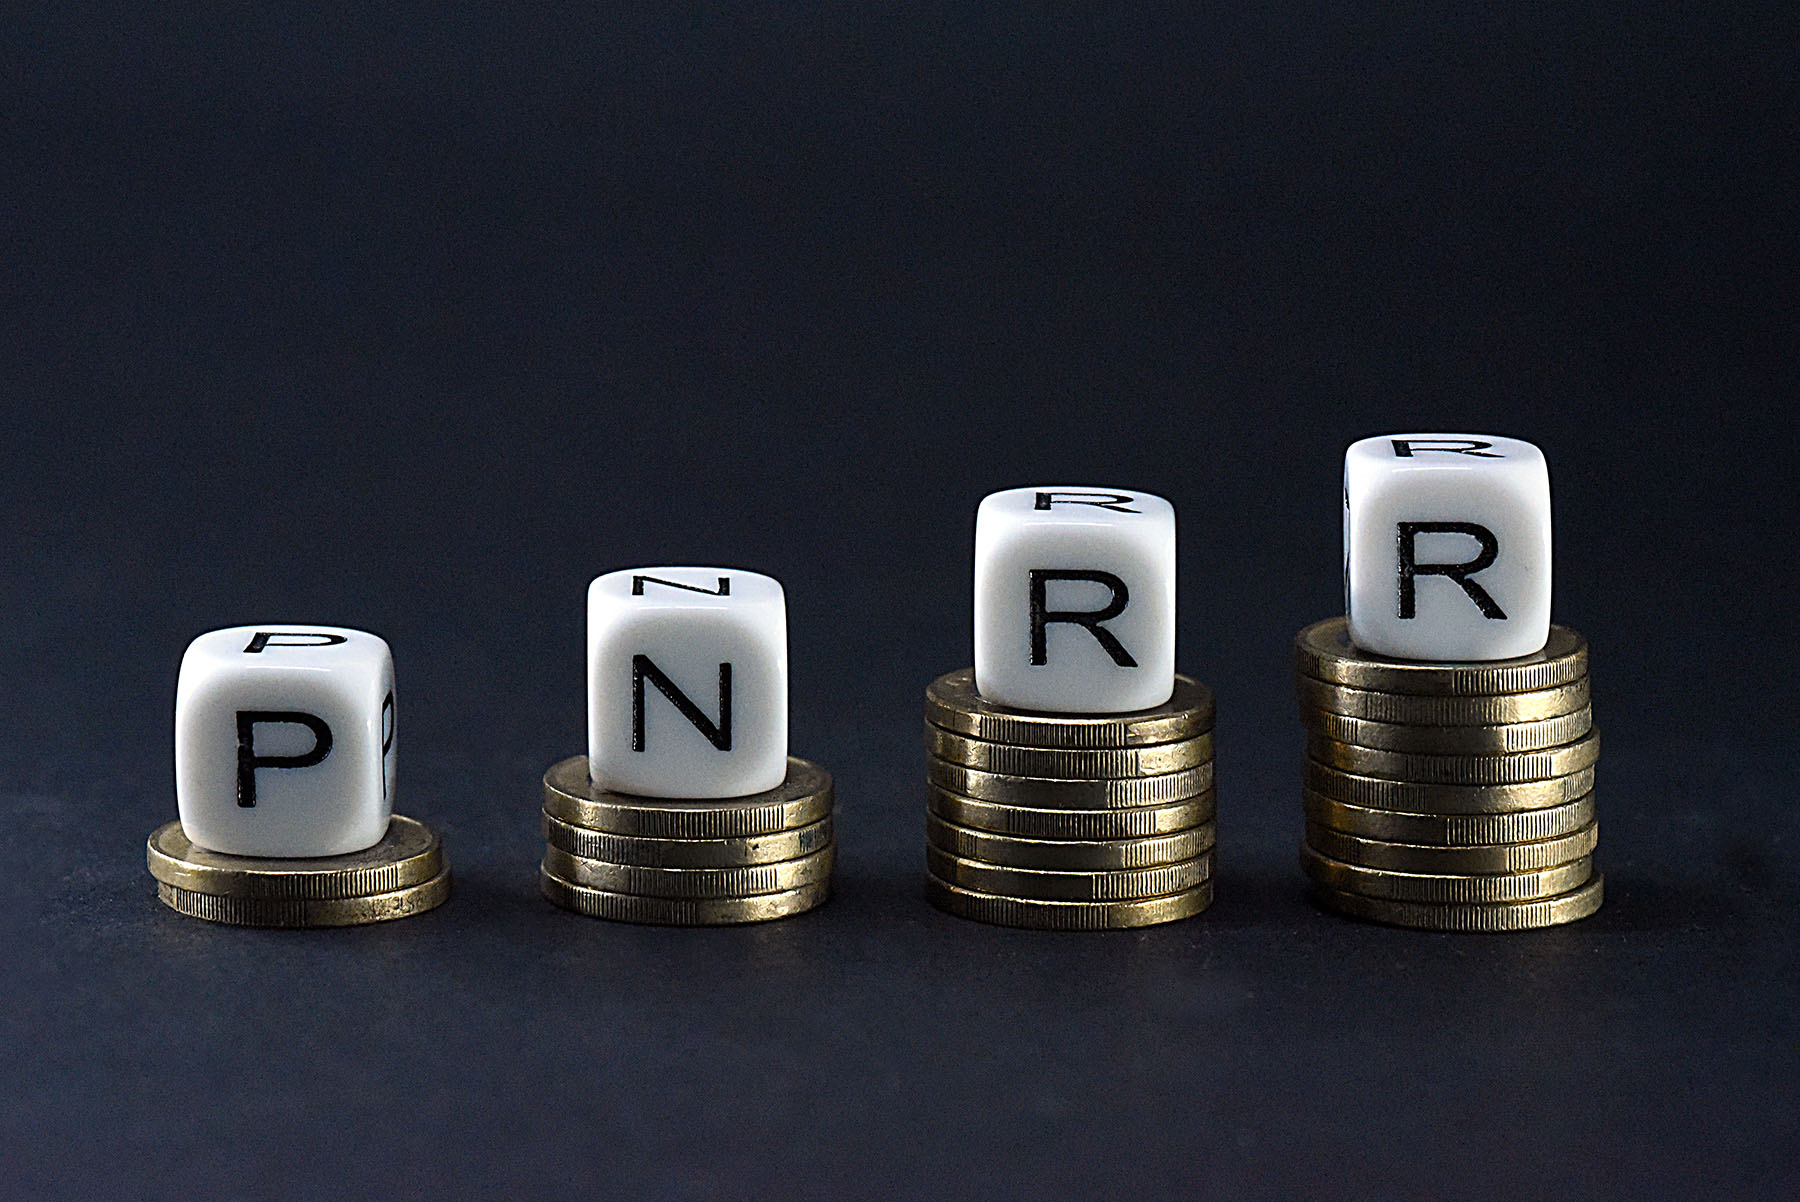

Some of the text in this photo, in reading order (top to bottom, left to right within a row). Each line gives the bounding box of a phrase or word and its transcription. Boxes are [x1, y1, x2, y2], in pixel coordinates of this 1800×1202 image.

[1391, 439, 1506, 458] R
[1034, 491, 1142, 514] R
[631, 575, 731, 596] N
[1396, 521, 1508, 620] R
[243, 632, 348, 654] P
[1029, 568, 1138, 668] R
[632, 654, 732, 753] N
[236, 710, 333, 808] P
